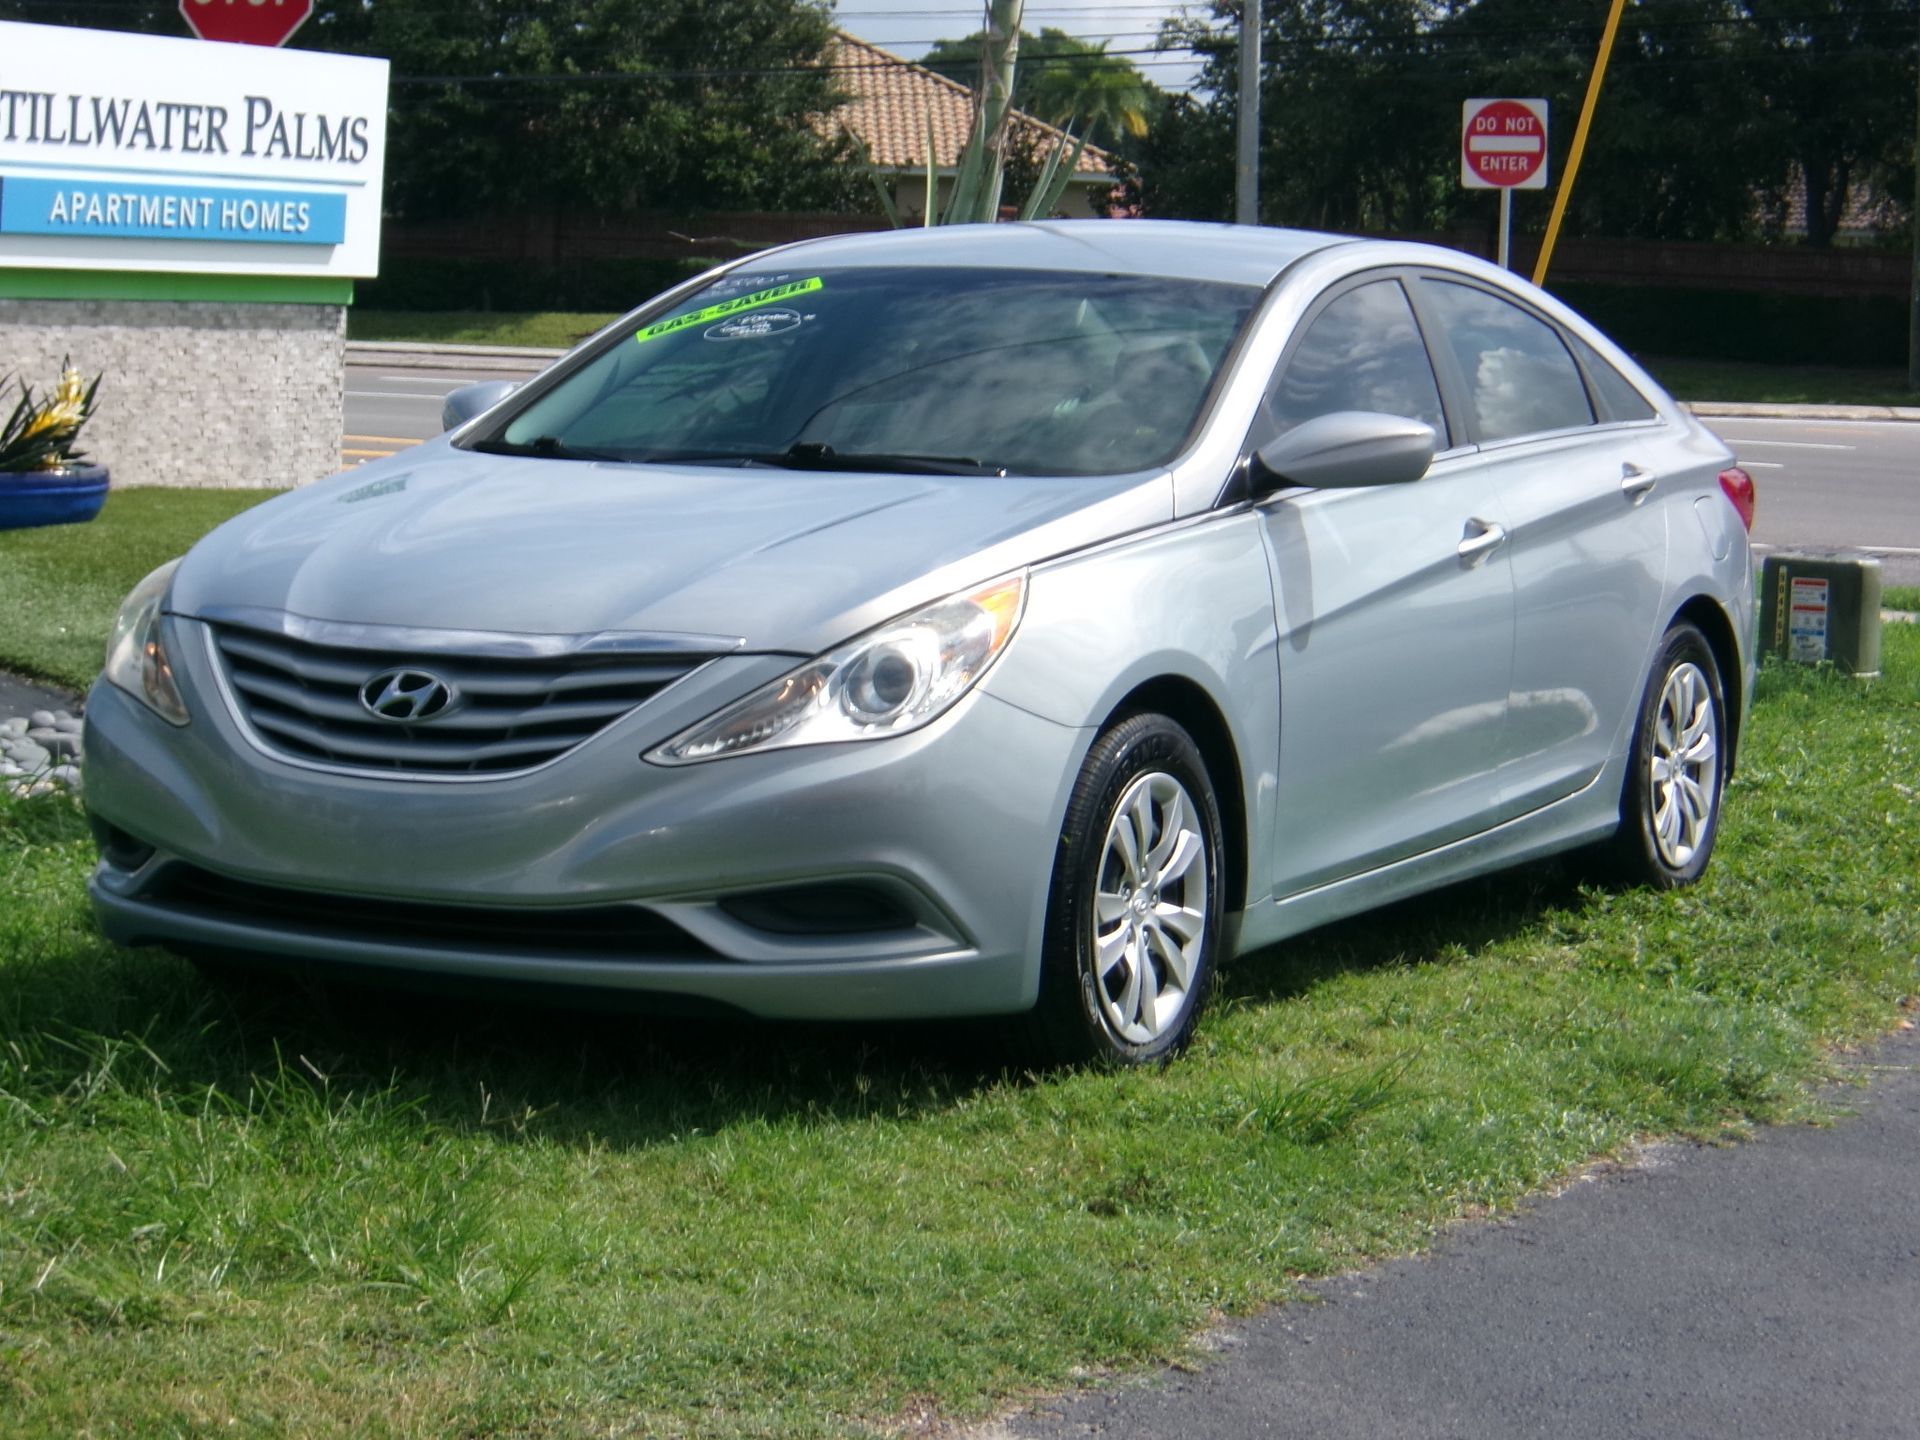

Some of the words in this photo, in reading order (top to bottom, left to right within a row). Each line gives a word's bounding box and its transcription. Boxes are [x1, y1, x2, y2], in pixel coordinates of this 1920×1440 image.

[0, 89, 229, 155] TILLWATER
[241, 95, 369, 164] PALMS
[1476, 117, 1497, 132] DO
[1505, 117, 1535, 132] NOT
[1480, 156, 1528, 171] ENTER
[48, 191, 214, 229] APARTMENT
[220, 199, 311, 232] HOMES
